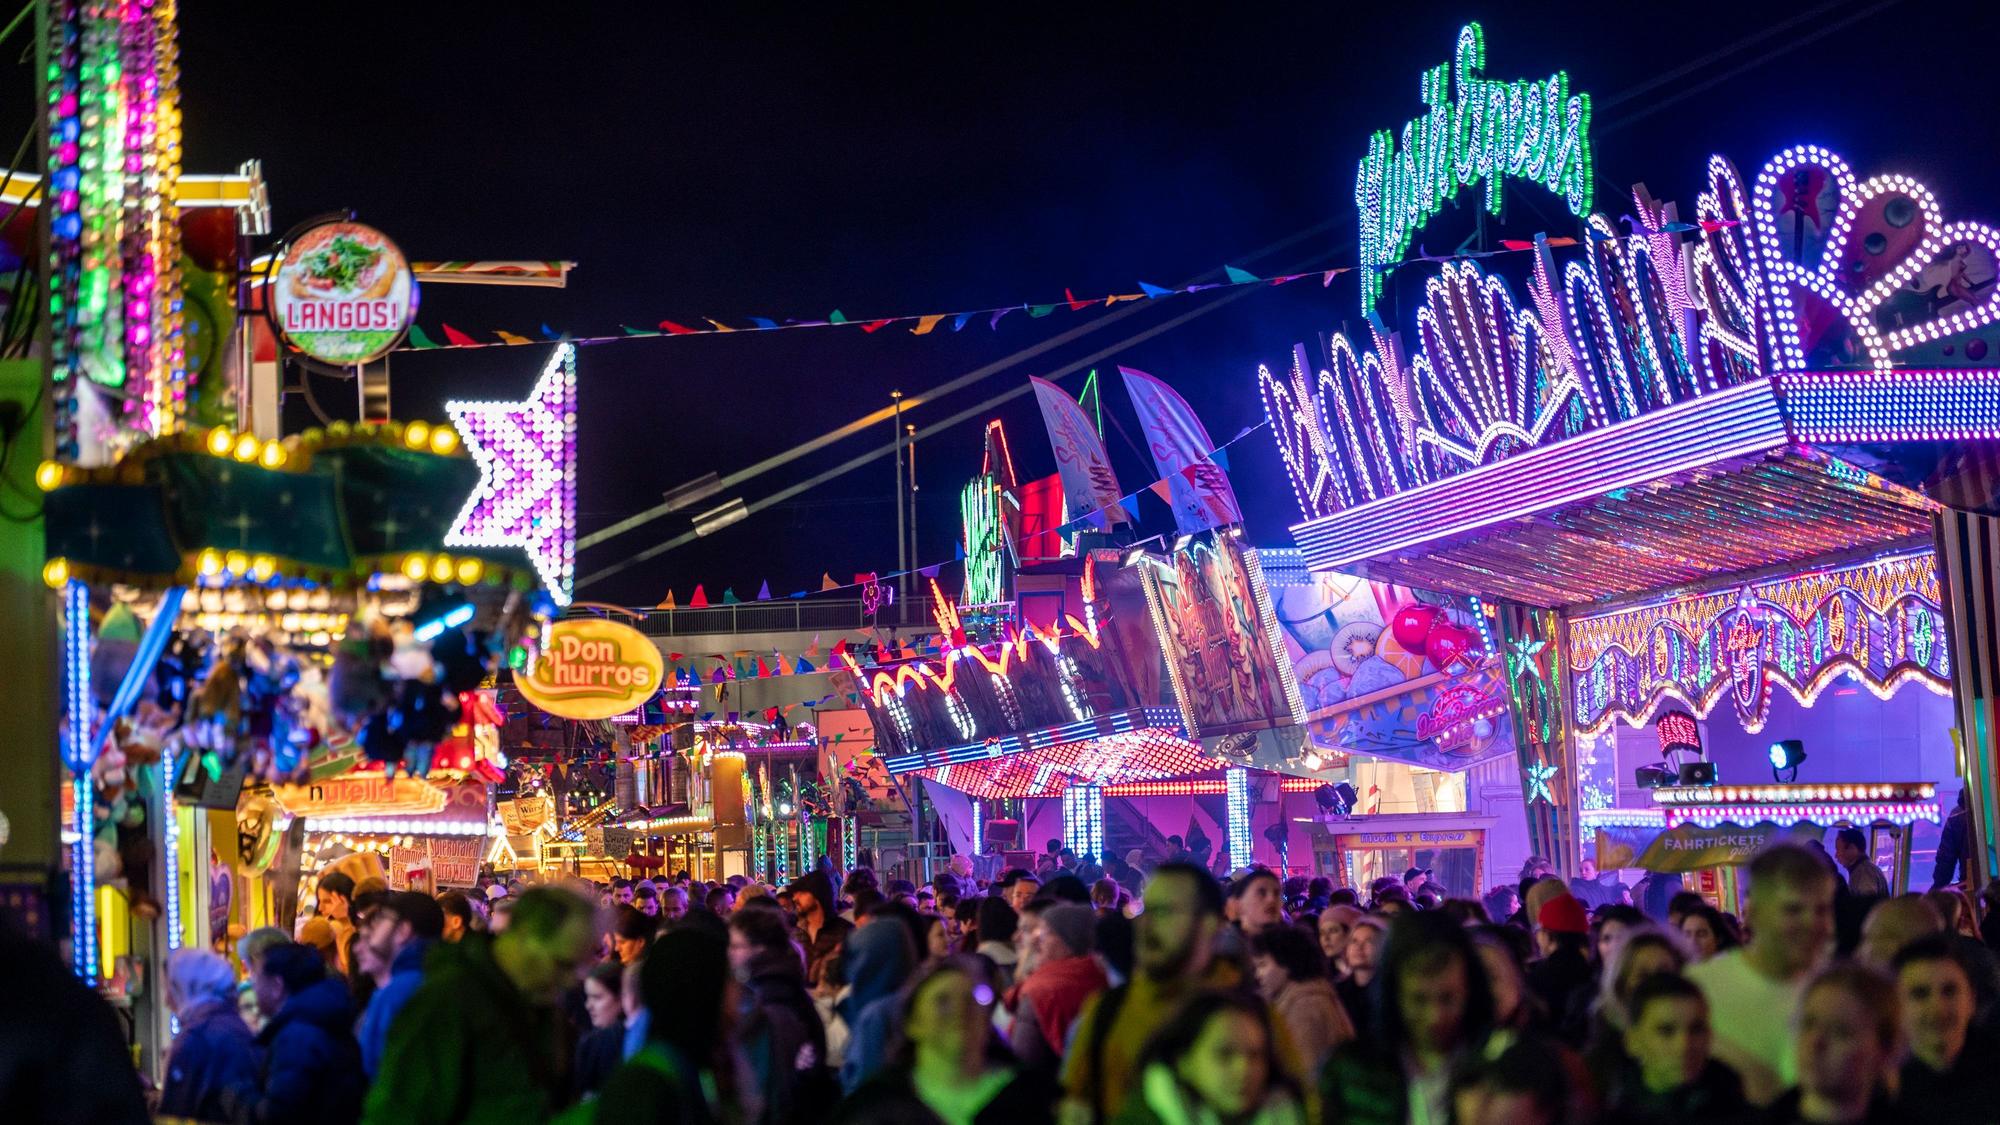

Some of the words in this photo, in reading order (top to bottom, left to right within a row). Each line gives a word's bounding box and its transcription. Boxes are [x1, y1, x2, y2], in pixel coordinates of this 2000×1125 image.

[286, 301, 399, 330] LANGOS!
[559, 634, 614, 663] Don
[527, 649, 650, 694] Churros
[309, 778, 395, 801] nutella
[1360, 832, 1397, 844] Musik
[1664, 835, 1765, 850] FAHRTICKETS
